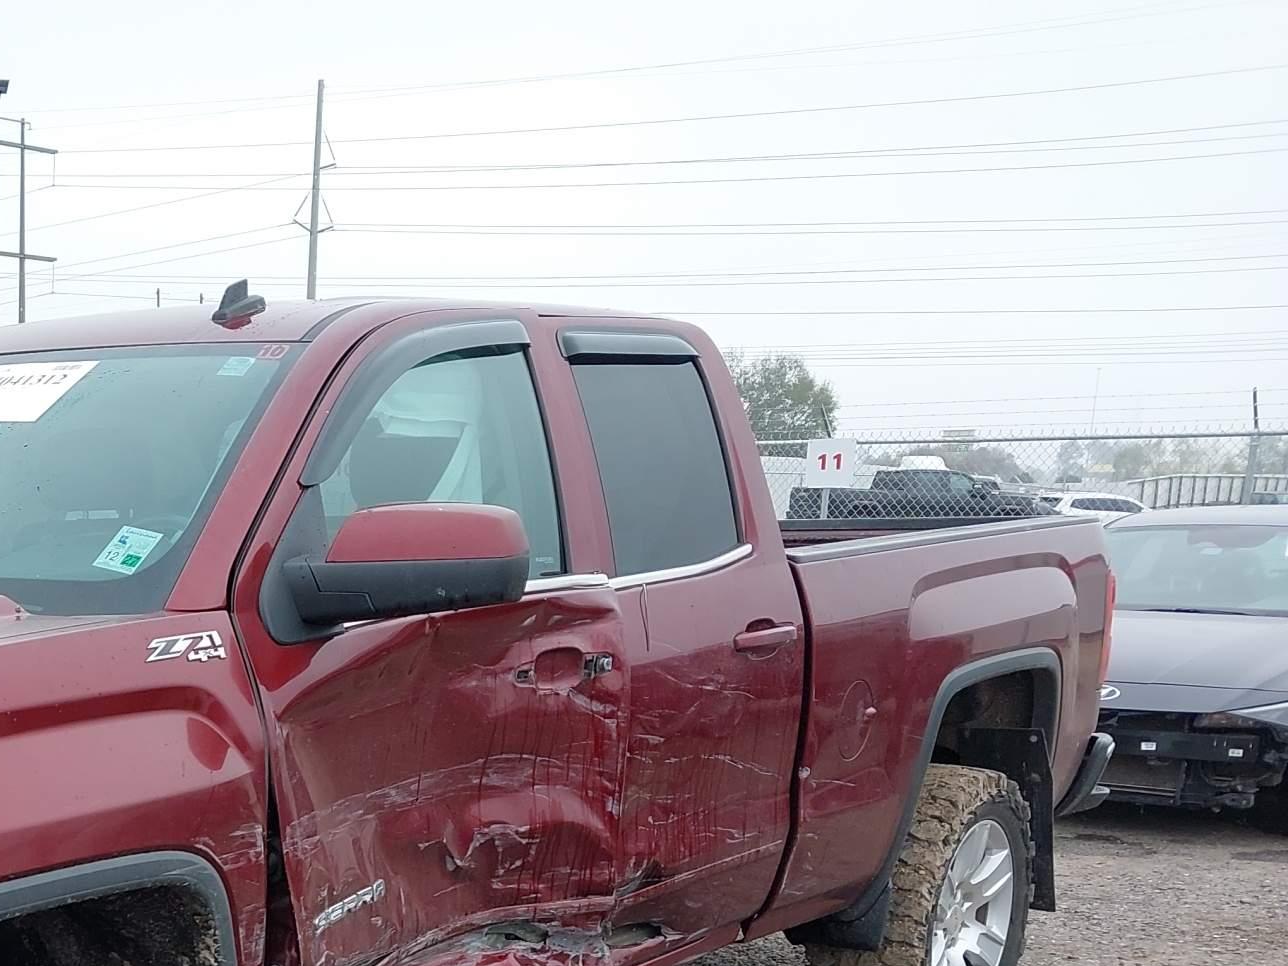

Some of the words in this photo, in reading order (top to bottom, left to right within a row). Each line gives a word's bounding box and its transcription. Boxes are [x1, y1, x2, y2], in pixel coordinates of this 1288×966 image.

[817, 453, 842, 470] 11
[104, 551, 120, 561] 12
[145, 630, 223, 662] Z71
